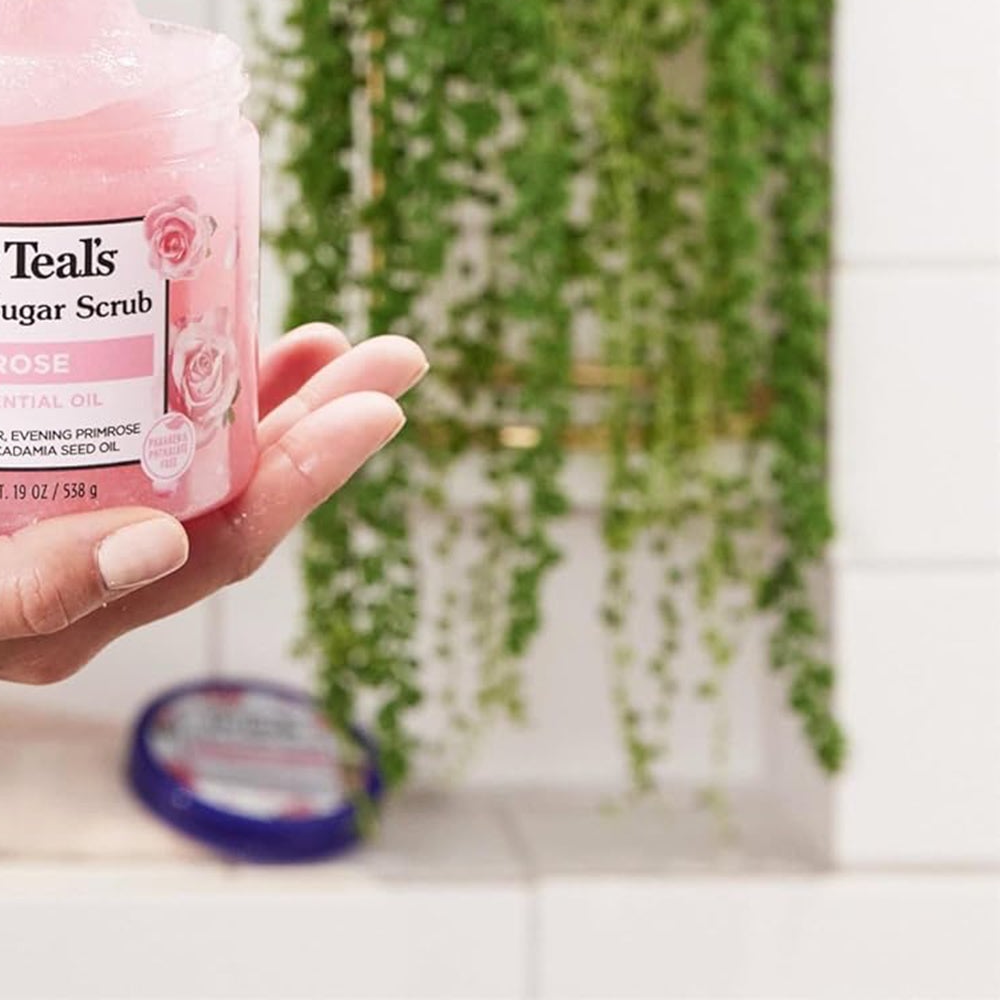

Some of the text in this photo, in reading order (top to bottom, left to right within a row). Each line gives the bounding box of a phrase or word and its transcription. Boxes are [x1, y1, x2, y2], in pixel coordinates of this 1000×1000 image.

[4, 237, 118, 280] Teal's
[76, 291, 152, 318] Scrub
[71, 394, 103, 407] OIL
[11, 429, 72, 441] EVENING
[75, 423, 141, 439] PRIMROSE
[61, 443, 95, 456] SEED
[98, 442, 120, 453] OIL
[14, 484, 26, 499] 19
[32, 484, 48, 499] OZ
[53, 482, 59, 500] /
[64, 483, 86, 498] 538
[91, 485, 97, 499] g
